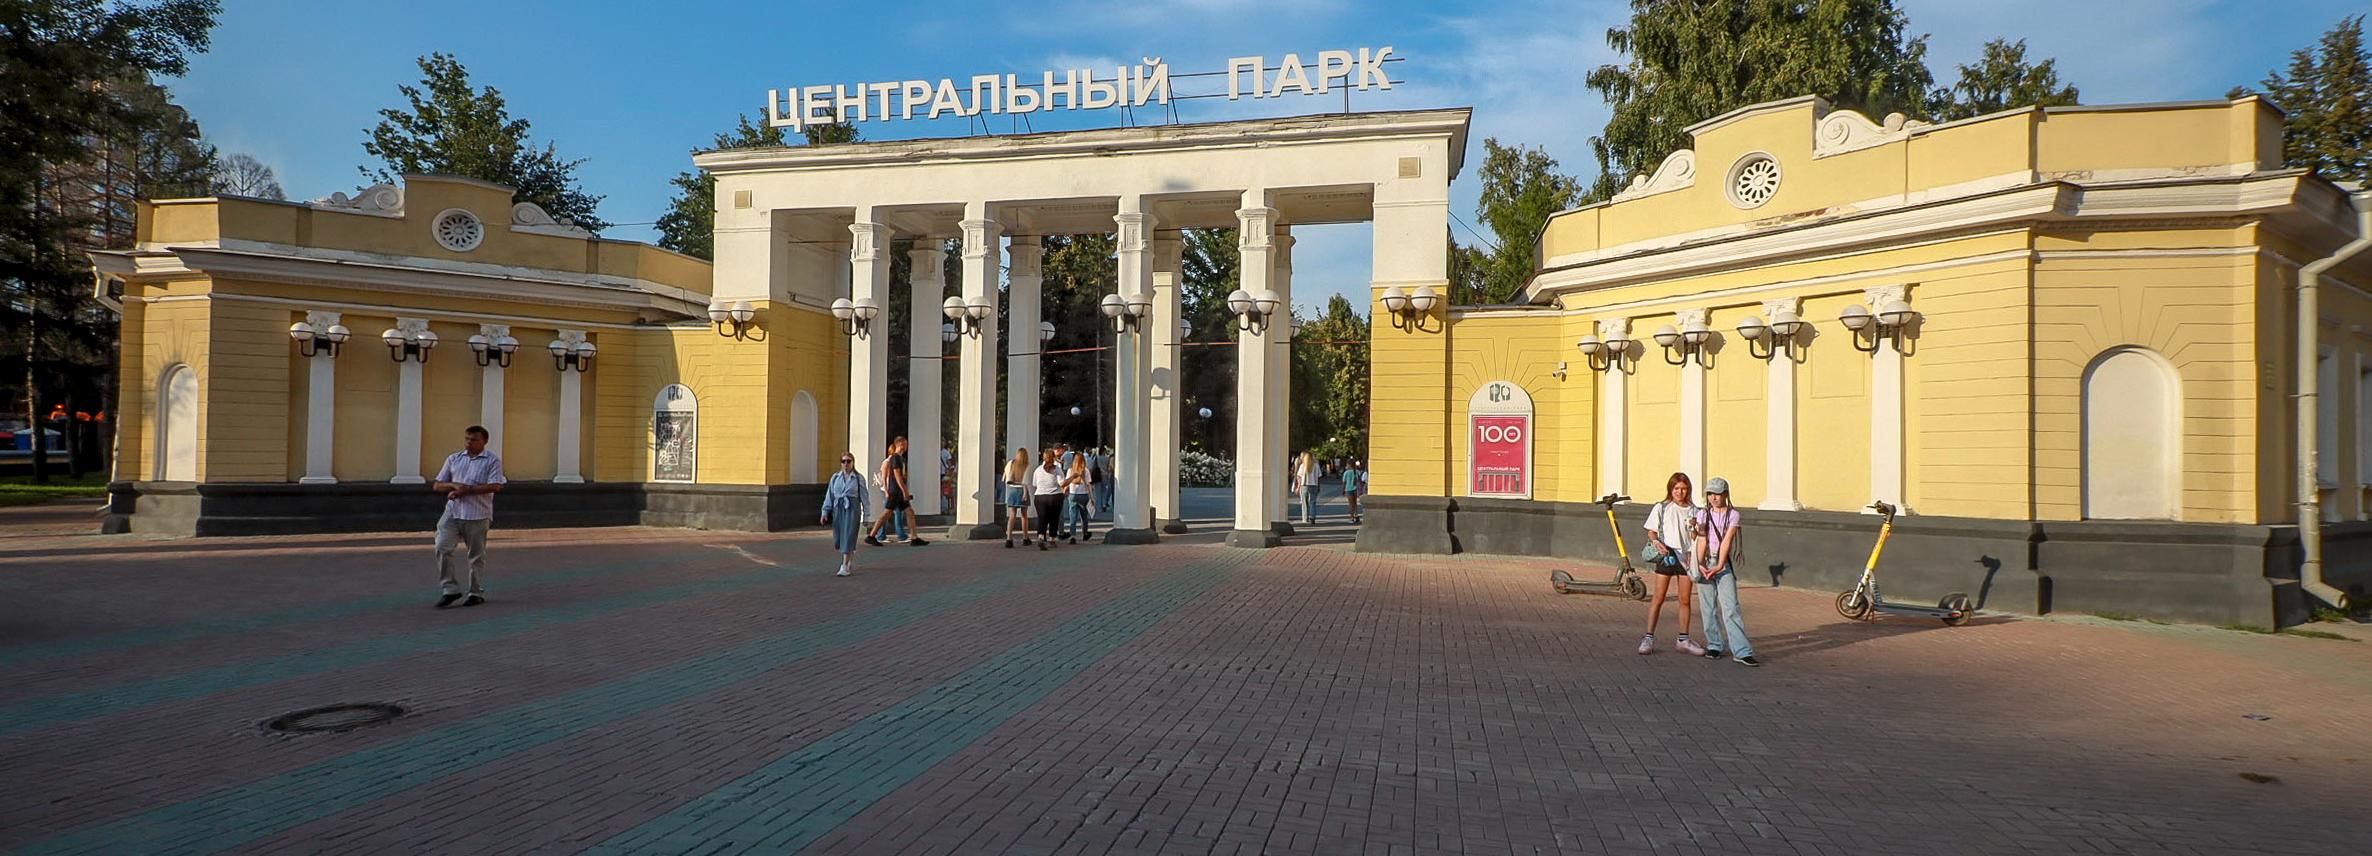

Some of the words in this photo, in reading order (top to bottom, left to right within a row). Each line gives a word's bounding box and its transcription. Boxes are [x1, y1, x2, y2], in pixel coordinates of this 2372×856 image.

[768, 56, 1169, 133] ЦЕНТРАЛЬНЫЙ
[1228, 46, 1393, 101] ПАРК
[1478, 425, 1521, 443] 100
